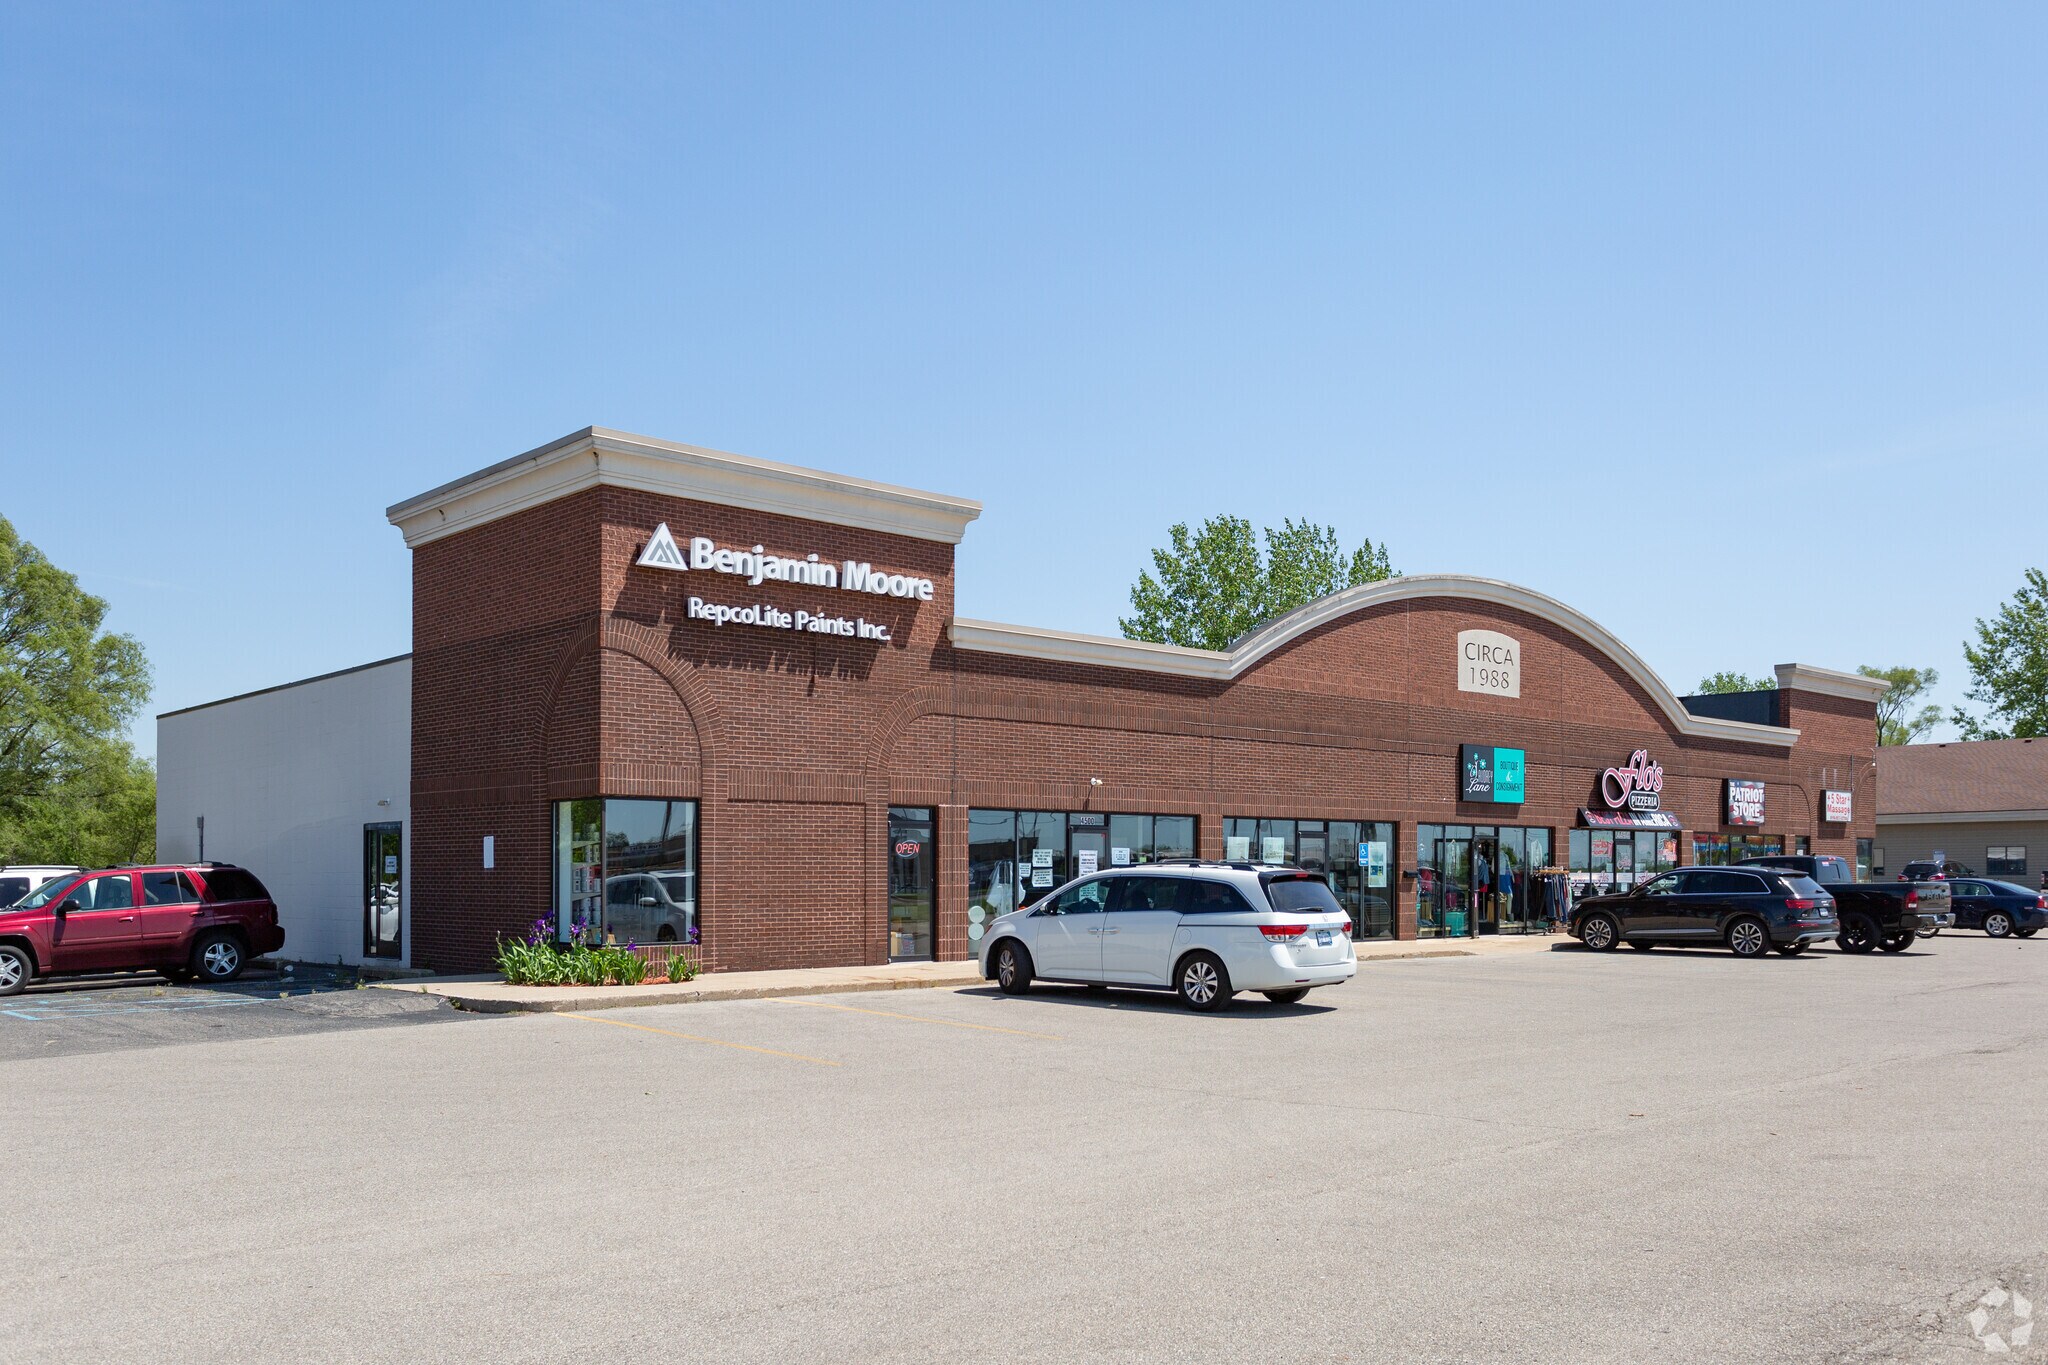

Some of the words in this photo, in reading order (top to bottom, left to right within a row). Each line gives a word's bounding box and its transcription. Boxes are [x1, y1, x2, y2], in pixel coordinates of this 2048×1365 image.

[690, 537, 837, 588] Benjamin
[842, 560, 934, 601] Moore
[688, 596, 792, 627] RepcoLite
[795, 610, 855, 637] Paints
[857, 617, 891, 641] Inc.
[1464, 641, 1514, 667] CIRCA
[1470, 667, 1510, 690] 1988
[1500, 760, 1519, 771] BOUTIQUE
[1465, 777, 1491, 793] Lane
[1631, 795, 1657, 807] PIZZERIA
[1729, 786, 1764, 803] PATRIOT
[1836, 793, 1847, 805] Star
[1733, 801, 1760, 817] STORE
[1827, 804, 1850, 815] Massage
[896, 841, 920, 854] OPEN
